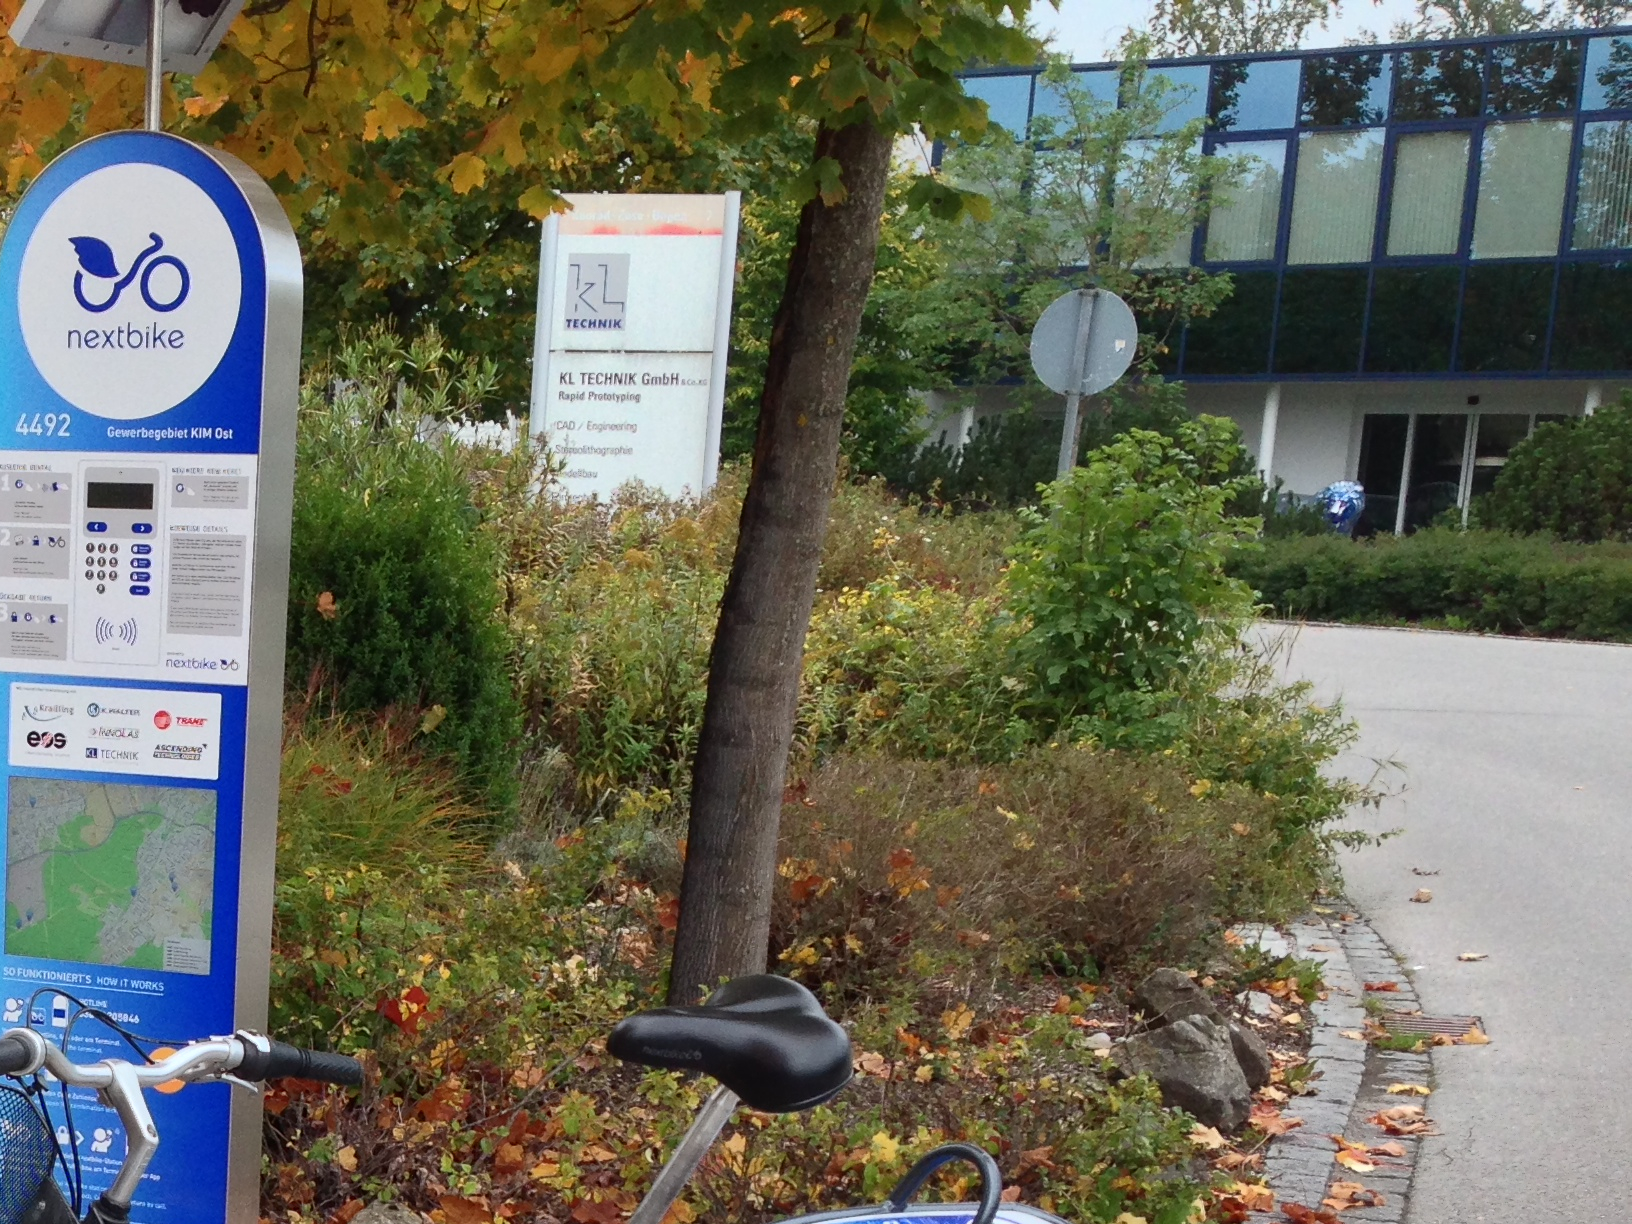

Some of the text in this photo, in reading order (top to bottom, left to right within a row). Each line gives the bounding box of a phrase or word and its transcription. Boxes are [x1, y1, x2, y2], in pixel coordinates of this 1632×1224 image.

[565, 318, 623, 329] TECHNIK
[67, 321, 185, 350] nextbike
[559, 372, 575, 386] KL
[579, 372, 637, 386] TECHNIK
[641, 372, 679, 386] GmbH
[558, 390, 641, 403] Rapid Prototyping
[15, 413, 71, 437] 4492
[556, 420, 576, 432] CAD
[586, 420, 638, 433] Engineering
[107, 425, 234, 441] Gewerbegebiet KIM Ost
[0, 528, 11, 546] 2
[165, 657, 218, 671] nextbike
[100, 748, 140, 761] TECHNIK
[3, 966, 16, 977] SO
[96, 976, 118, 987] HOW
[120, 977, 129, 988] IT
[130, 979, 165, 991] WORKS
